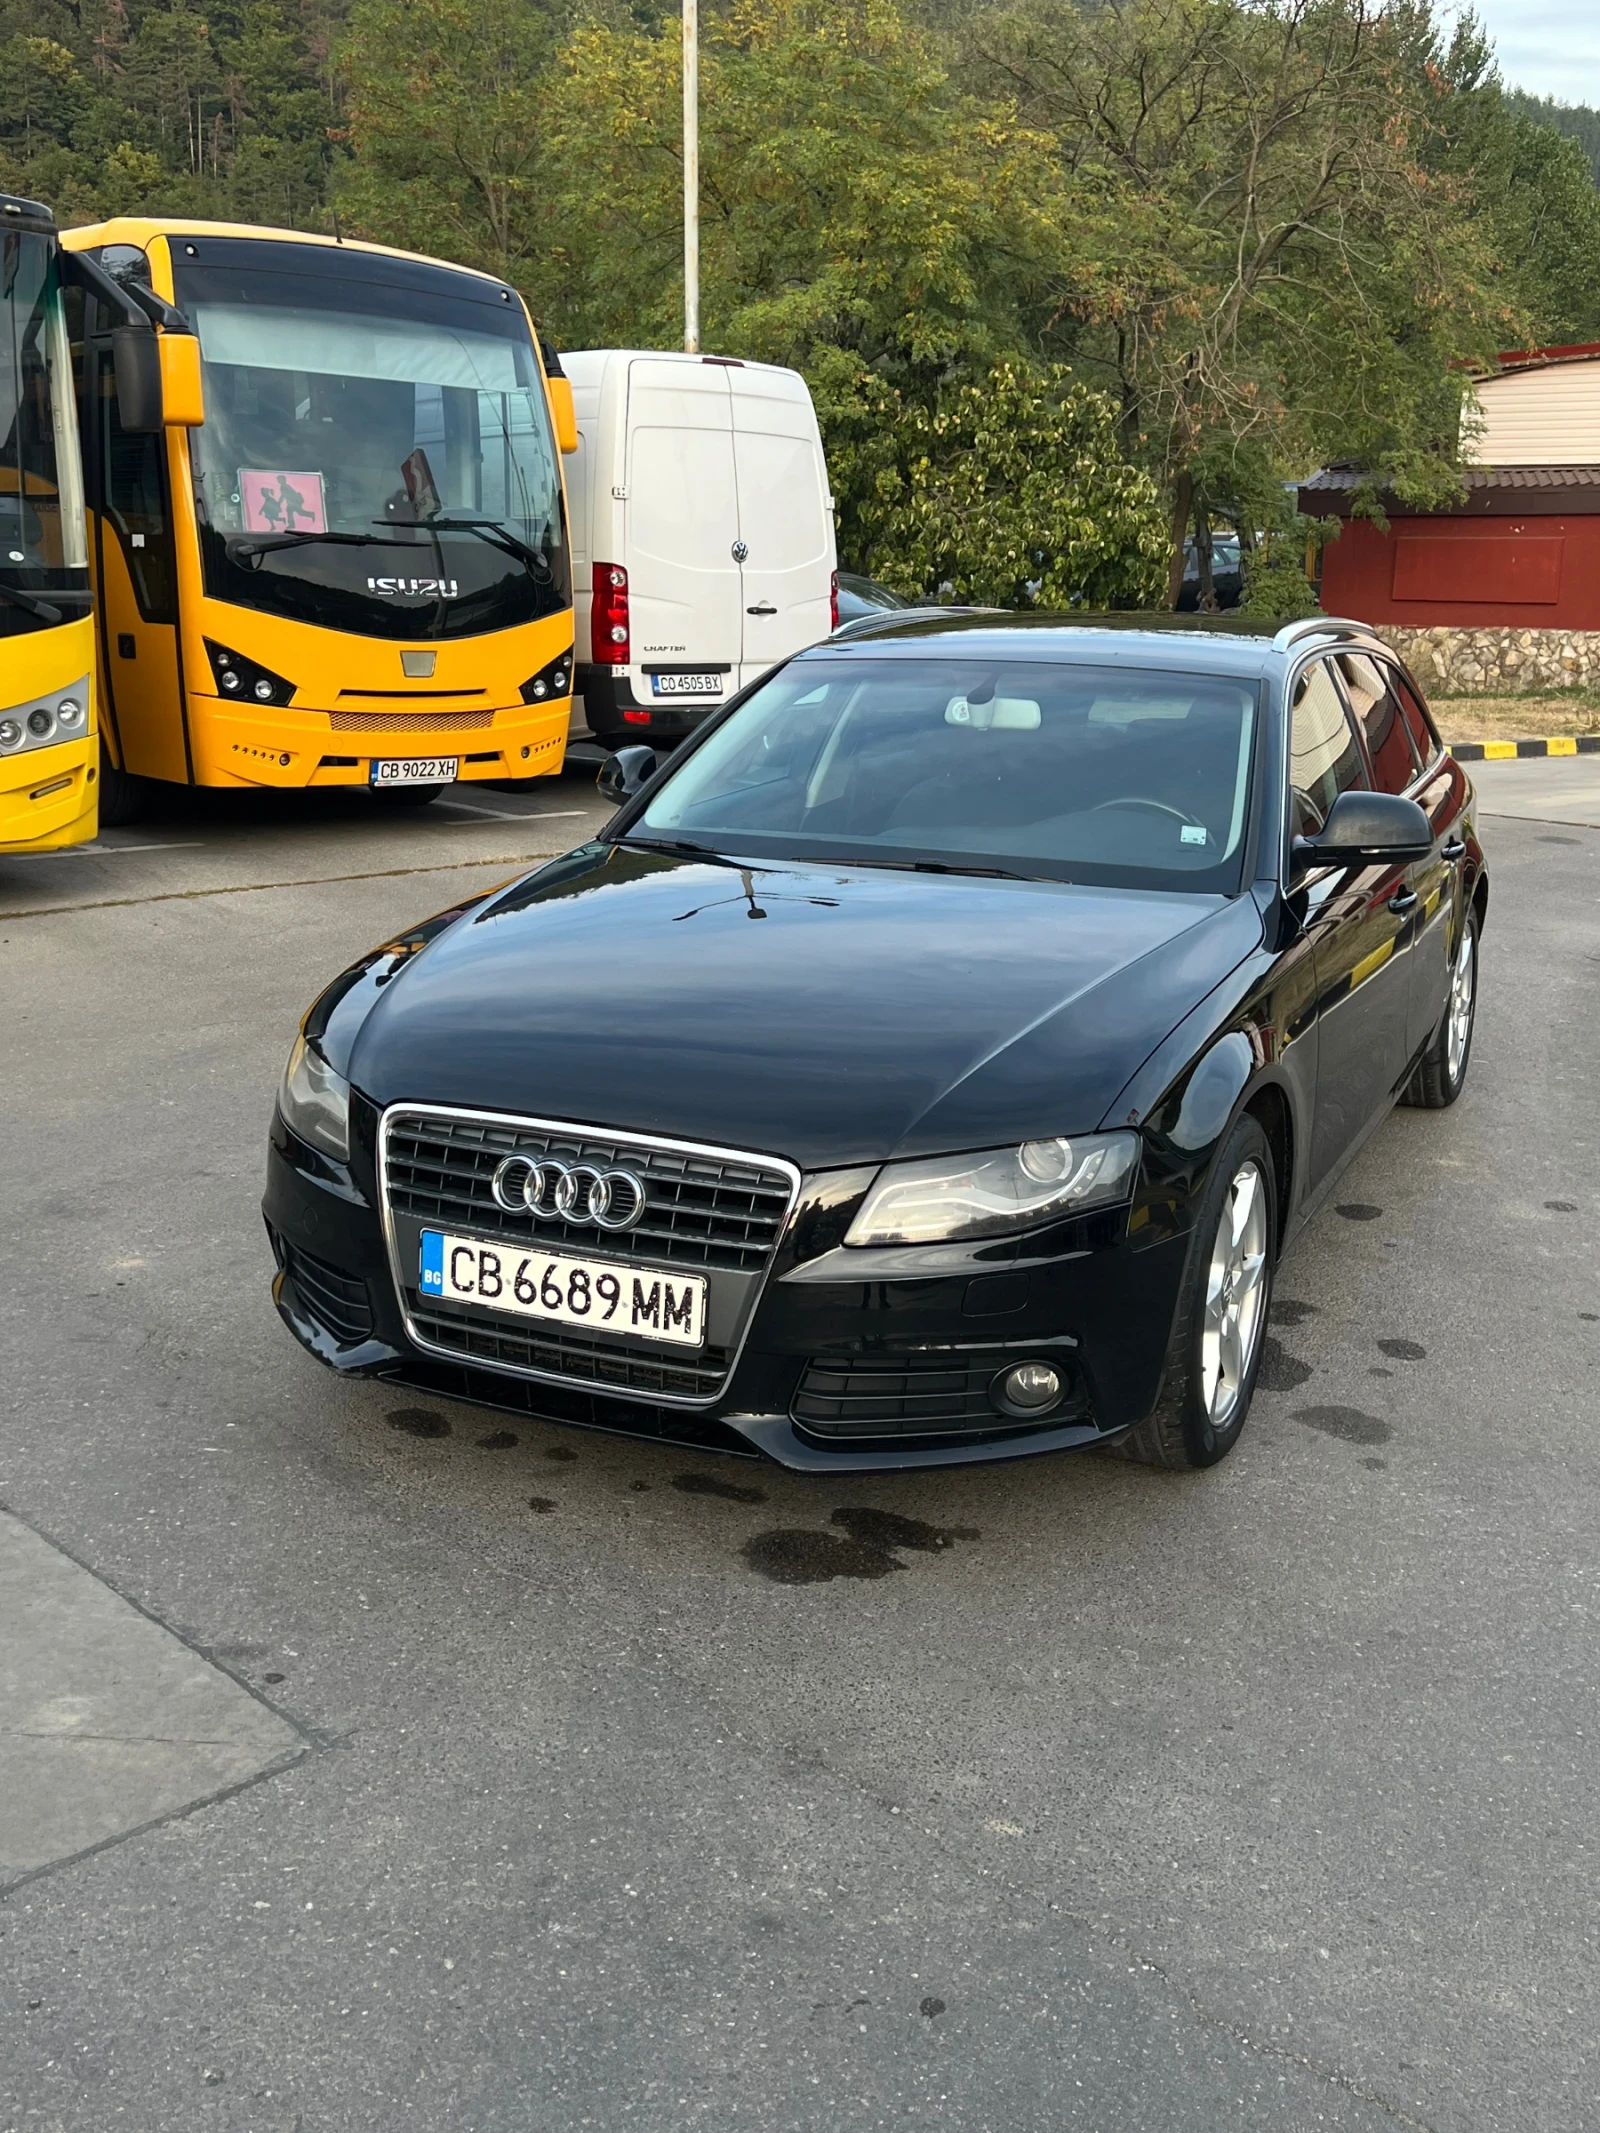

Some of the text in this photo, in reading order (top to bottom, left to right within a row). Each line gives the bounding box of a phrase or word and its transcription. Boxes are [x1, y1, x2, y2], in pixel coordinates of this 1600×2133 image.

[367, 577, 458, 598] ISUZU
[660, 676, 719, 691] CO 4505 BX
[381, 760, 455, 778] CB 9022 XH
[424, 1268, 442, 1286] BG
[451, 1246, 694, 1335] CB 6689 MM
